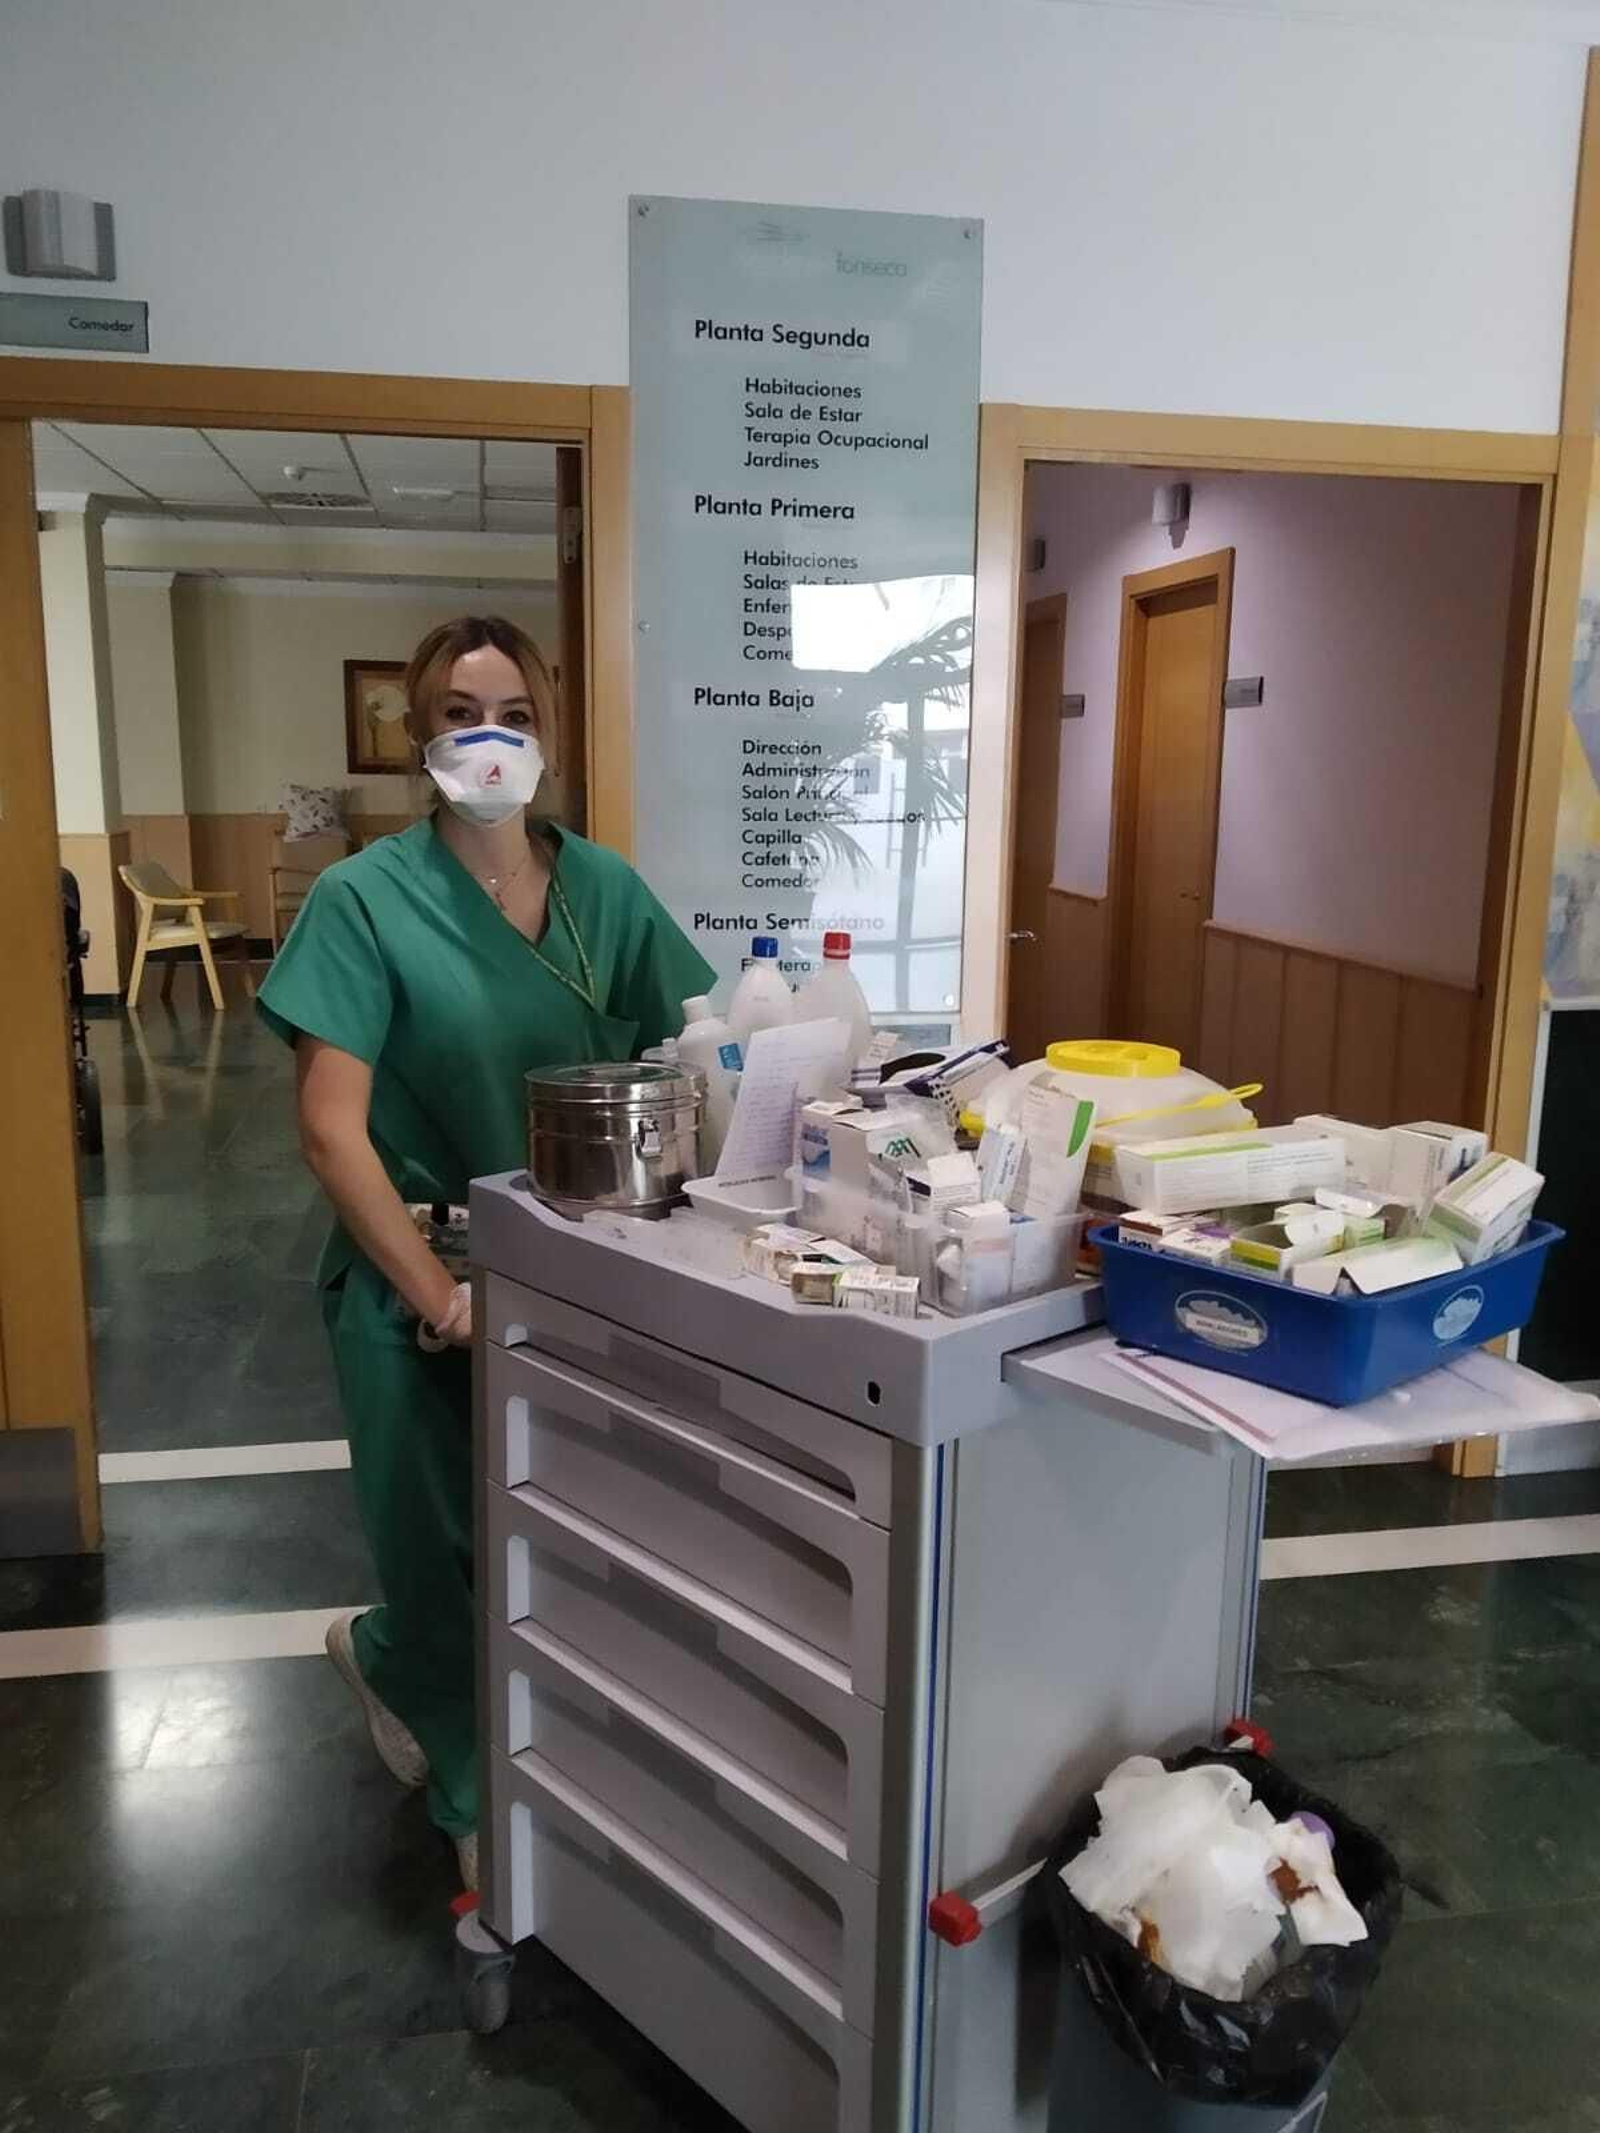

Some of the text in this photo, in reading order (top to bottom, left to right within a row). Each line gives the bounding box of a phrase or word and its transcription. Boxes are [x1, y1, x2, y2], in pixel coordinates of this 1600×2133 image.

[68, 317, 134, 332] Comedor
[694, 319, 870, 350] Planta Segunda
[745, 377, 863, 399] Habitaciones
[744, 402, 863, 423] Sala de Estar
[745, 427, 930, 451] Terapia Ocupacional
[744, 451, 821, 470] Jardines
[693, 494, 856, 520] Planta Primera
[743, 550, 859, 570] Habitaciones
[693, 687, 815, 712] Planta Baja
[742, 739, 822, 756] Dirección
[742, 784, 790, 800] Salón
[742, 808, 778, 822] Sala
[741, 830, 802, 848] Capilla
[693, 913, 758, 931] Planta
